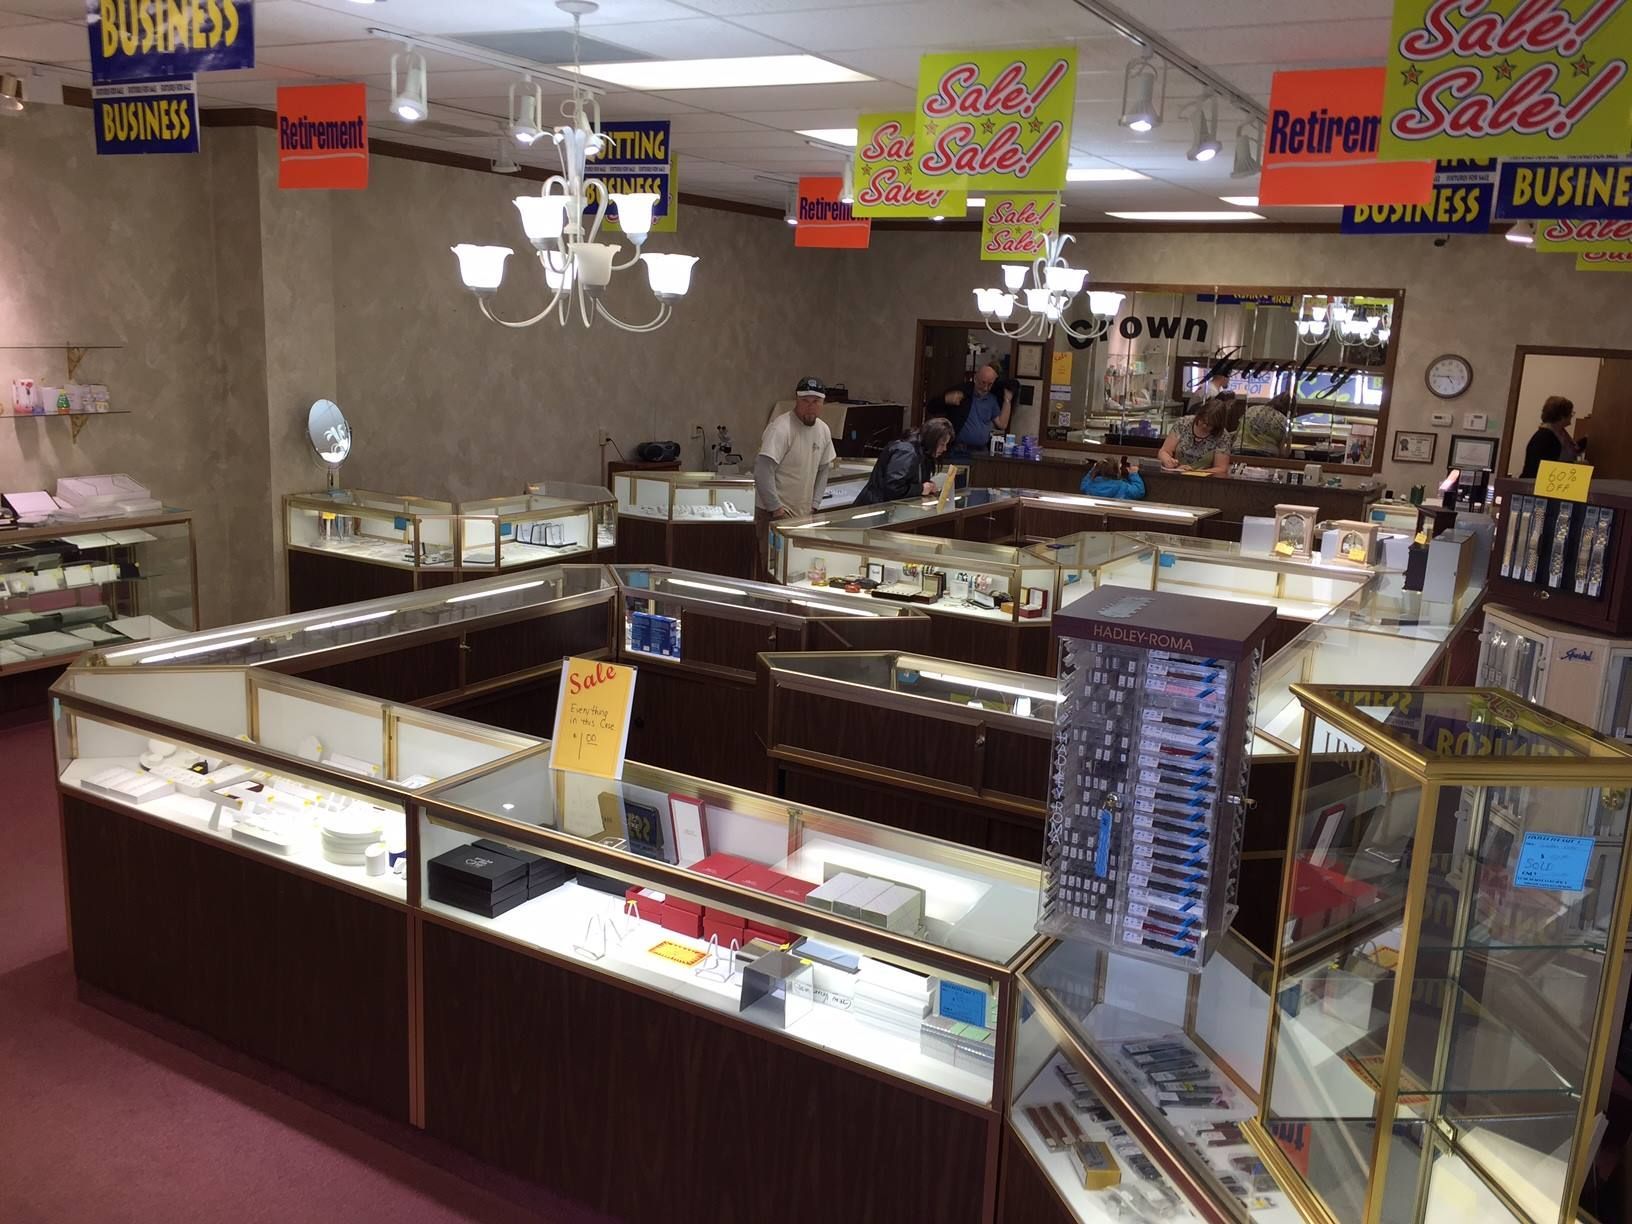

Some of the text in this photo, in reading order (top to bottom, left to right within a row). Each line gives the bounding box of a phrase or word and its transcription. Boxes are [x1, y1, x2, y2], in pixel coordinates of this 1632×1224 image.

[101, 0, 240, 58] BUSINESS
[923, 59, 1069, 118] Sale!
[1390, 59, 1628, 139] Sale!
[103, 100, 191, 143] BUSINESS
[279, 116, 365, 150] Retirement
[1268, 108, 1382, 154] Retirem
[585, 131, 665, 162] UITTING
[919, 121, 1064, 178] Sale!
[858, 166, 946, 208] Sae
[1512, 167, 1632, 207] BUSINE
[800, 196, 869, 221] Retirem
[985, 200, 1056, 226] Sale!
[1545, 482, 1571, 493] OFF
[1548, 467, 1577, 482] 60%
[1093, 623, 1194, 652] HADLEY-ROMA
[569, 662, 617, 695] Sale
[570, 702, 609, 721] Everything
